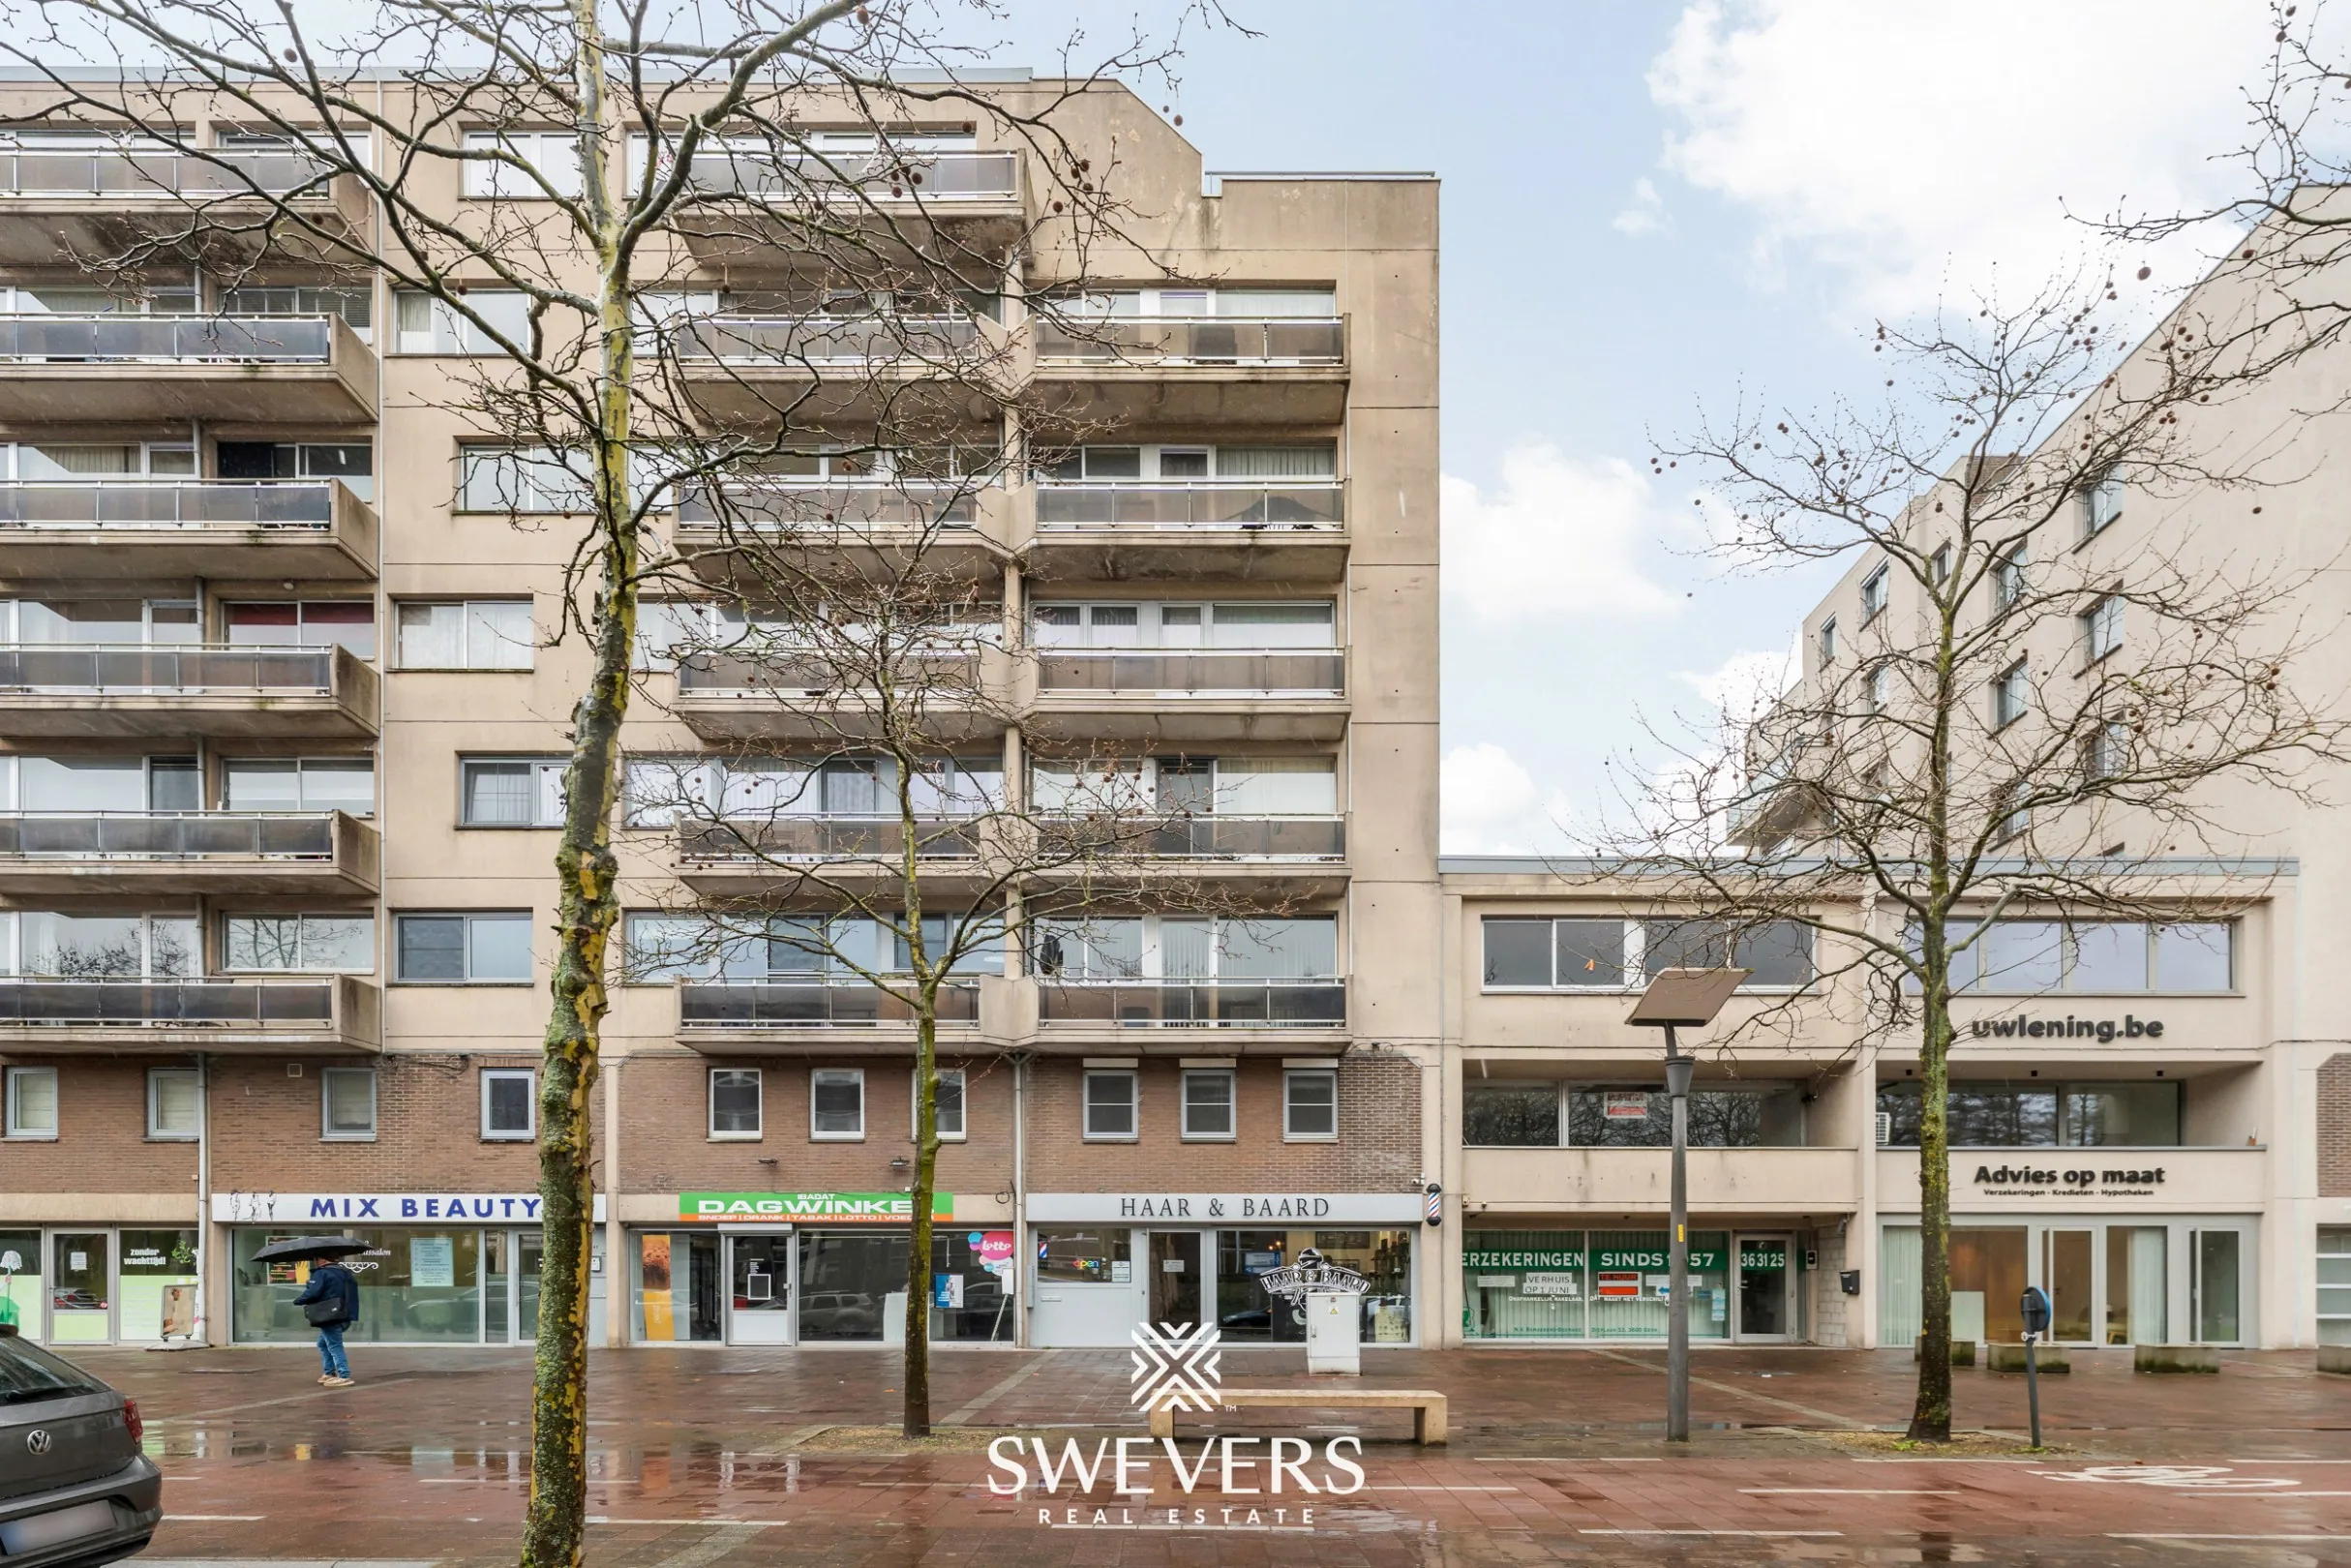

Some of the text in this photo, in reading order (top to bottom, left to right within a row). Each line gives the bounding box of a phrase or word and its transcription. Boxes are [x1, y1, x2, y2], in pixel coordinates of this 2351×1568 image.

[1972, 1014, 2164, 1042] uwlening.be
[1974, 1165, 2165, 1187] Advies op maat
[310, 1198, 542, 1218] MIX BEAUTY
[698, 1200, 934, 1214] DAGWINKE
[1120, 1198, 1330, 1217] HAAR & BAARD
[130, 1248, 160, 1256] zonder
[1462, 1252, 1584, 1266] ERZEKERINGEN
[1601, 1252, 1664, 1266] SINDS
[124, 1256, 166, 1266] wachttijd!
[1072, 1260, 1100, 1269] open
[1260, 1271, 1302, 1291] HAAR
[1319, 1271, 1371, 1293] BAARD
